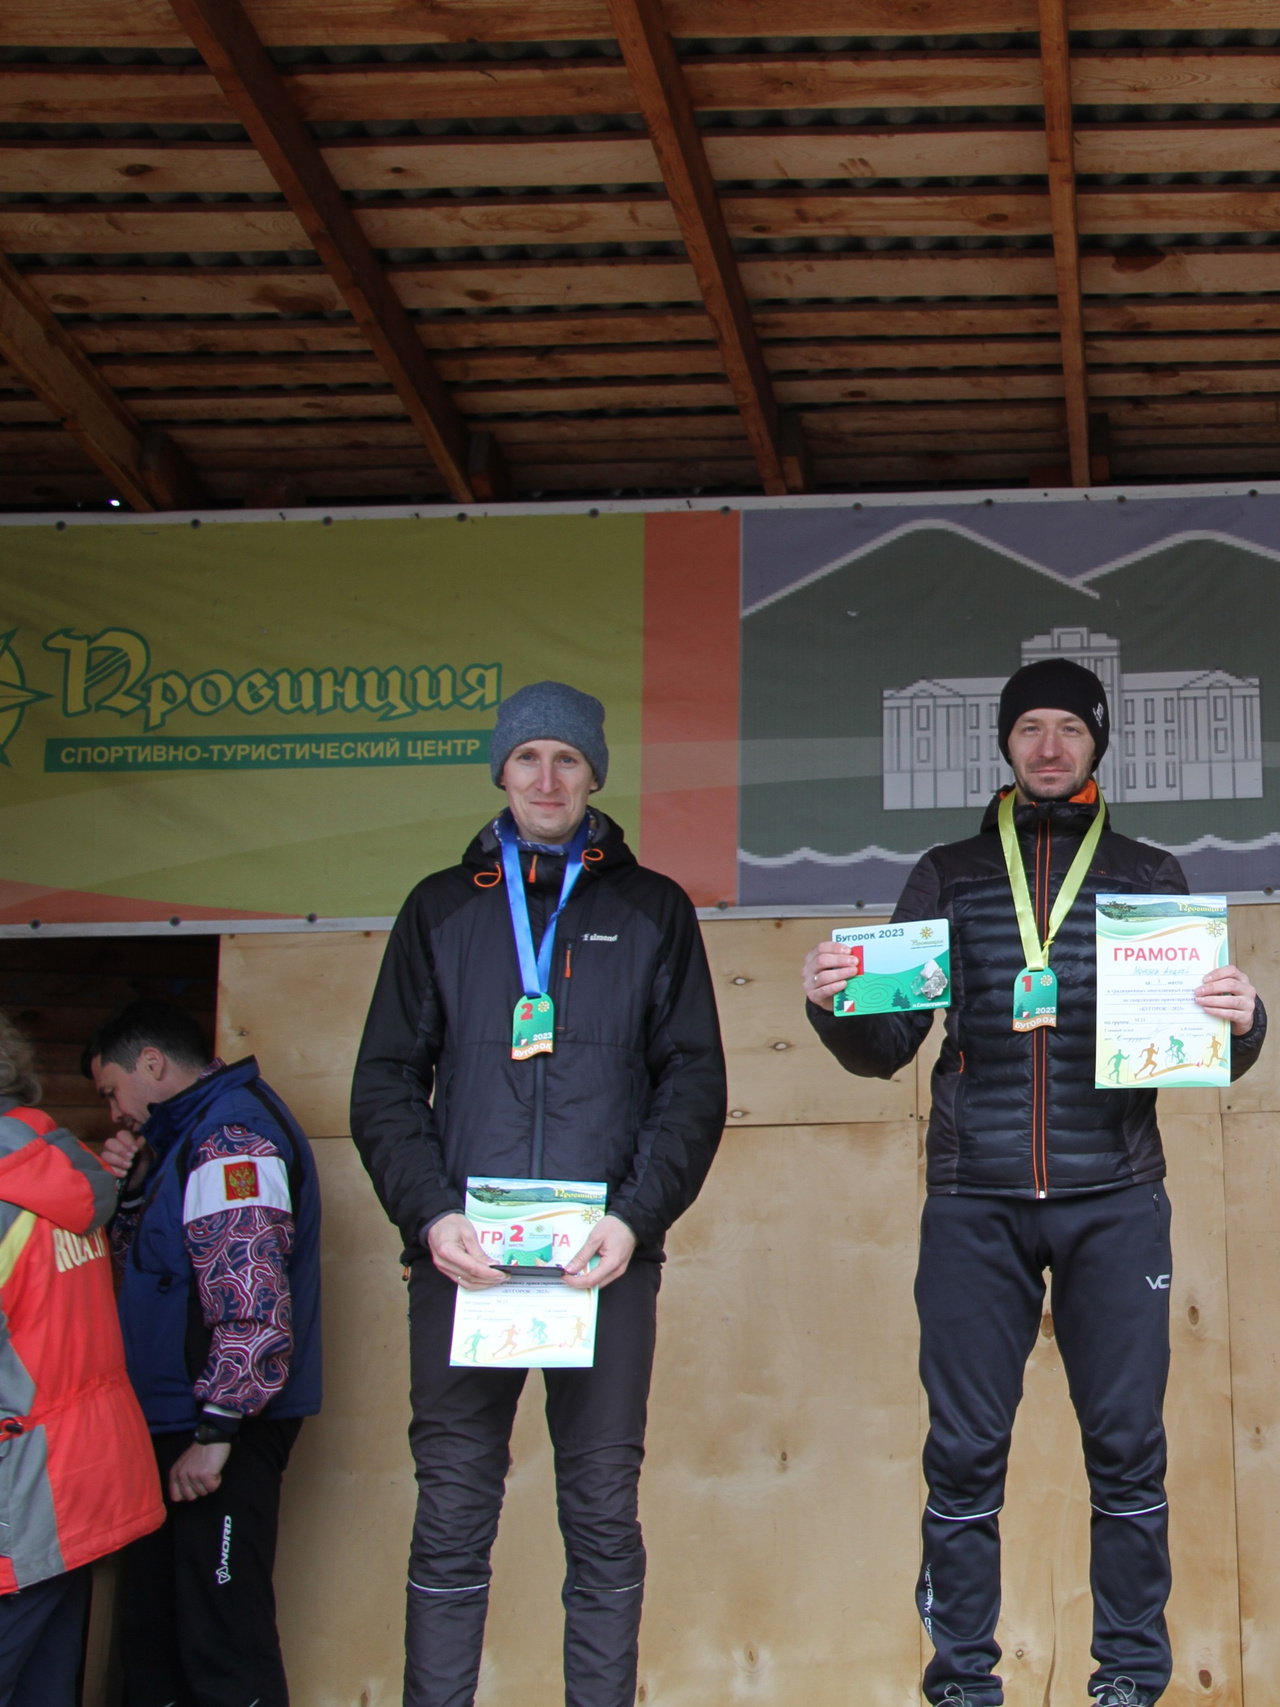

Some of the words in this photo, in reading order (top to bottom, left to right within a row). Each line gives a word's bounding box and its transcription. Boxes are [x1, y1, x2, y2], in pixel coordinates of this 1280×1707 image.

[42, 626, 502, 733] Провинция
[60, 737, 400, 765] СПОРТИВНО-ТУРИСТИЧЕСКИЙ
[407, 738, 480, 761] ЦЕНТР
[878, 928, 905, 938] 2023
[1113, 947, 1200, 961] ГРАМОТА
[1021, 975, 1032, 992] 1
[520, 1003, 533, 1020] 2
[1035, 1006, 1056, 1014] 2023
[1015, 1016, 1056, 1029] БУГОРОК
[532, 1032, 552, 1041] 2023
[514, 1042, 552, 1057] БУГОРОК
[510, 1224, 524, 1242] 2
[221, 1514, 232, 1566] NORD
[924, 1562, 934, 1614] VICTORY
